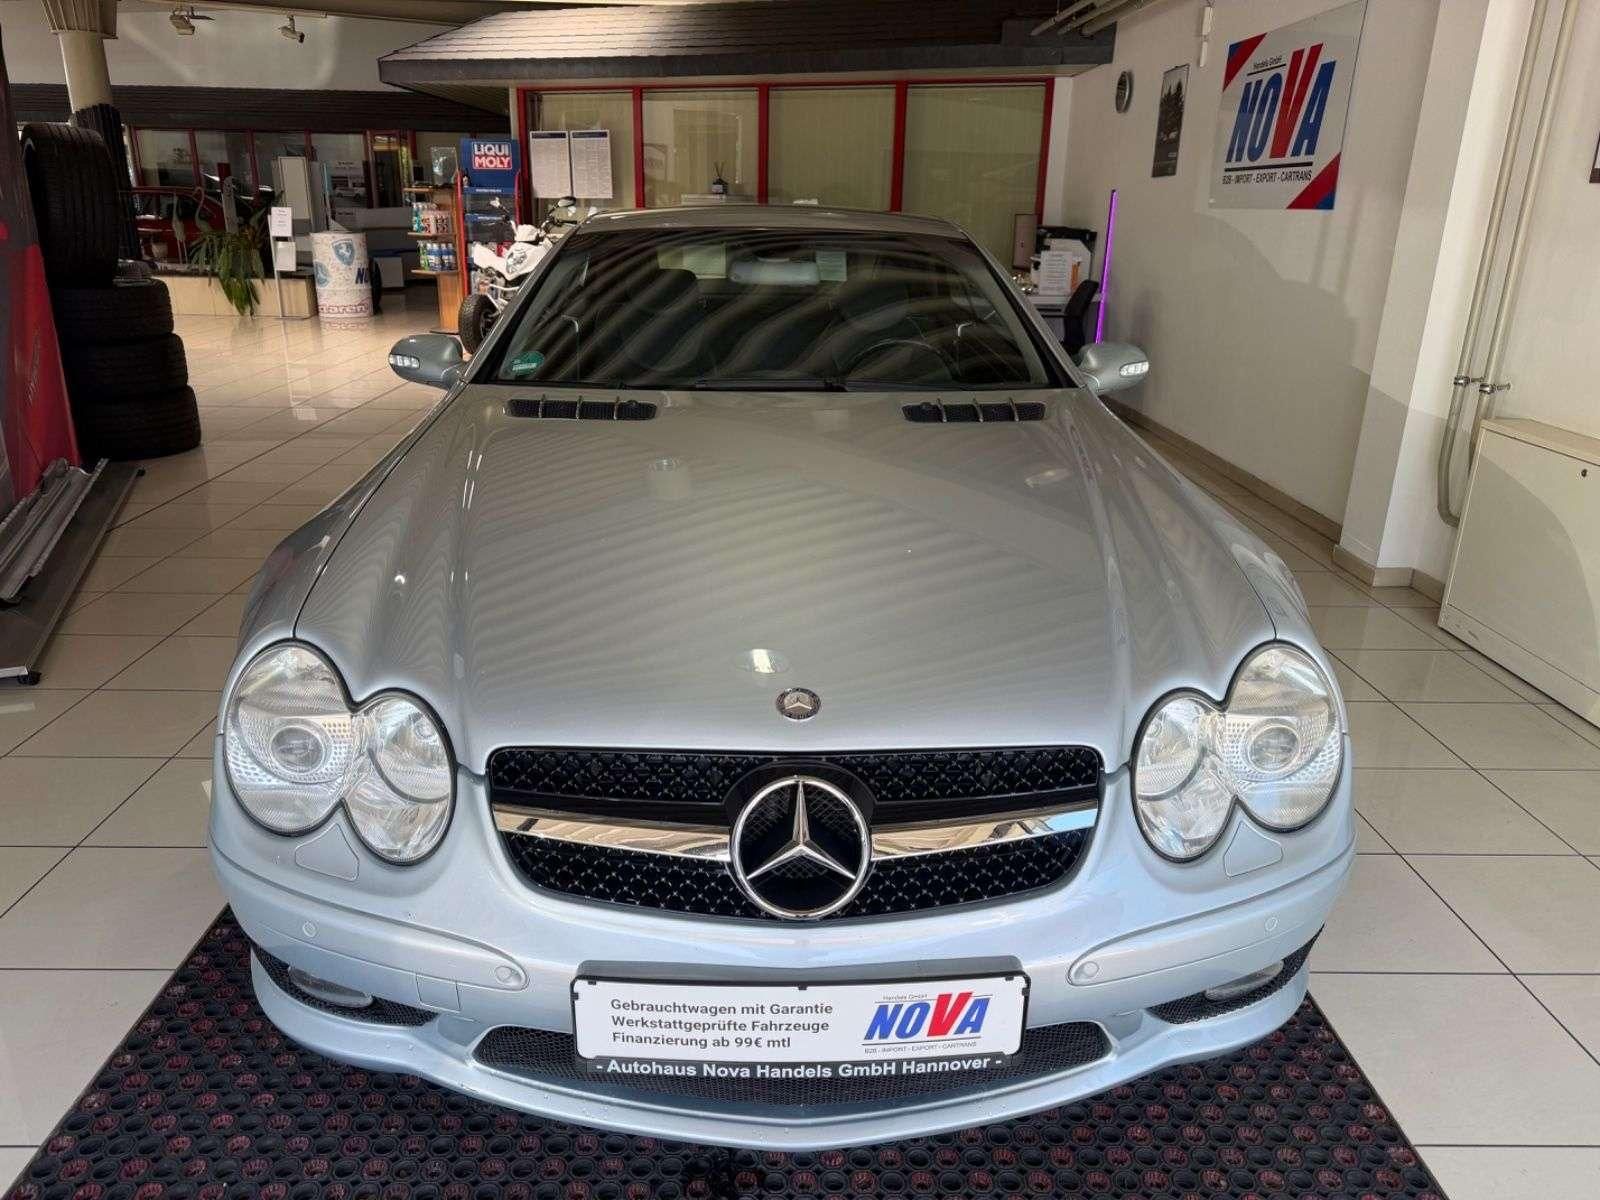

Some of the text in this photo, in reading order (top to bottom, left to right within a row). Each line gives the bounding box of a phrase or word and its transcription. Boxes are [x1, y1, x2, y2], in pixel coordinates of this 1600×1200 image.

[1225, 43, 1337, 163] NOVA
[474, 143, 510, 156] LIQUI
[474, 156, 511, 168] MOLY
[1235, 173, 1253, 184] IMPORT
[1256, 172, 1278, 183] EXPORT
[1280, 169, 1313, 182] CARTRANS
[610, 999, 833, 1017] Gebrauchtwagen mit Garantie
[863, 991, 991, 1041] NOVA
[612, 1015, 830, 1034] Werkstattgeprüfte Fahrzeuge
[612, 1032, 791, 1049] Finanzierung ab 99€ mtl
[606, 1059, 698, 1076] Autohaus
[702, 1063, 751, 1078] Nova
[756, 1064, 833, 1079] Handels
[838, 1062, 896, 1078] GmbH
[902, 1056, 991, 1075] Hannover
